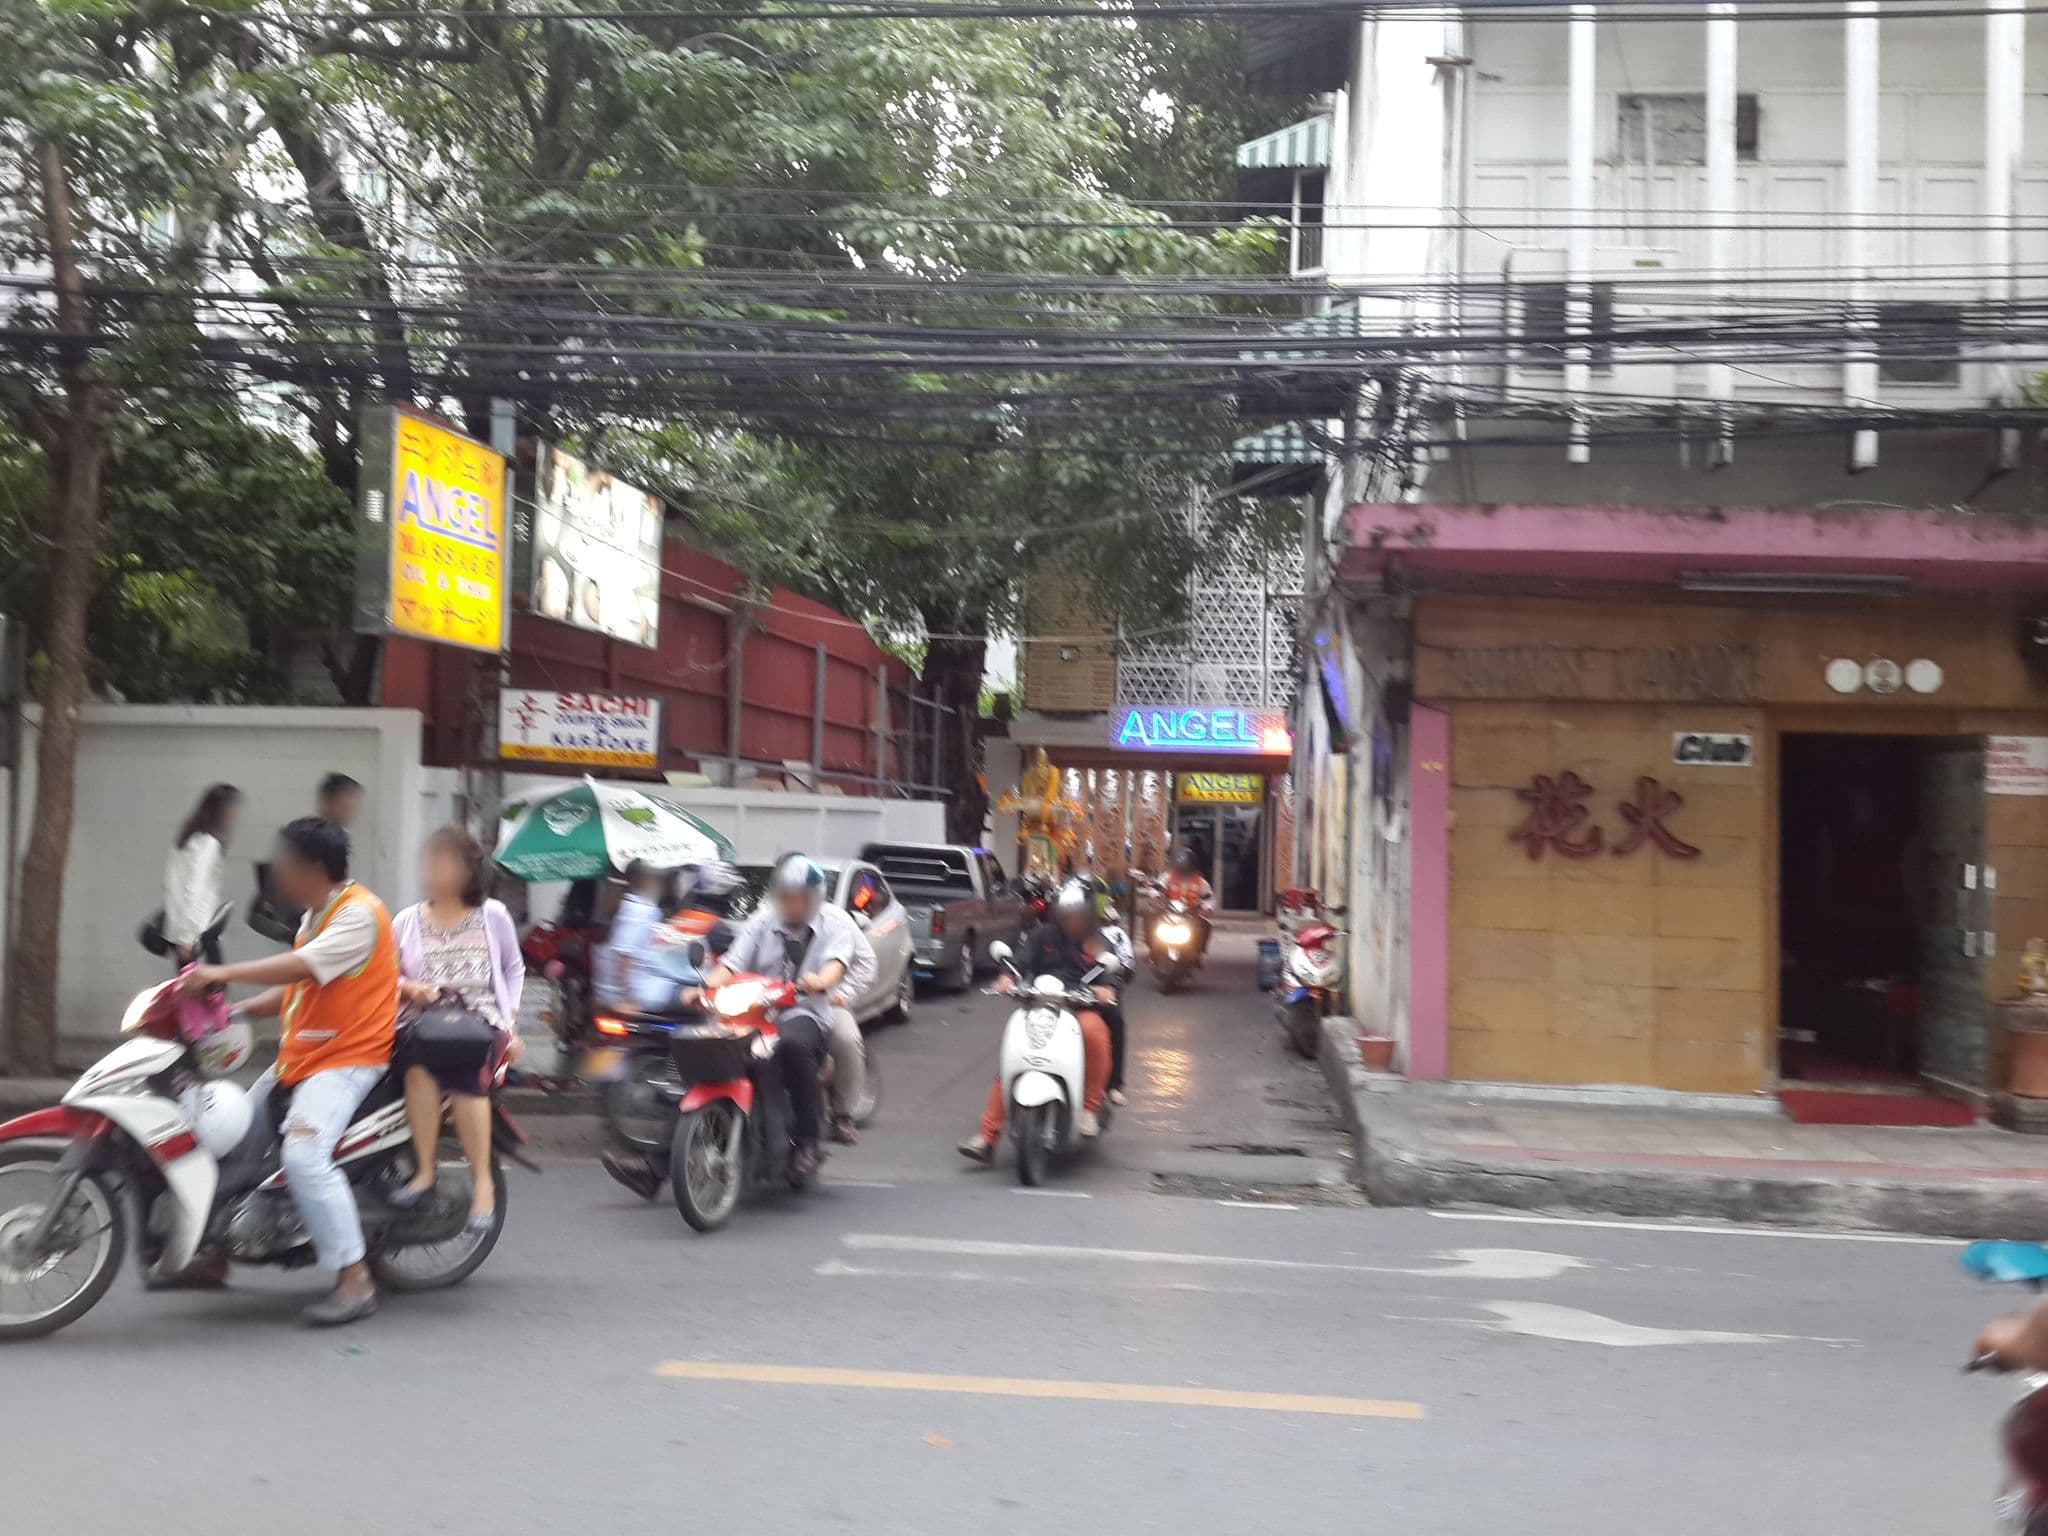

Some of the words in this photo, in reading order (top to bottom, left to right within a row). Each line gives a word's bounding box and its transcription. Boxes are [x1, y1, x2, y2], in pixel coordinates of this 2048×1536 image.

[400, 470, 497, 542] ANGEL
[556, 692, 649, 717] SACHI
[1119, 709, 1257, 746] ANGEL
[1186, 773, 1260, 791] ANGEL
[1507, 771, 1703, 862] 花火
